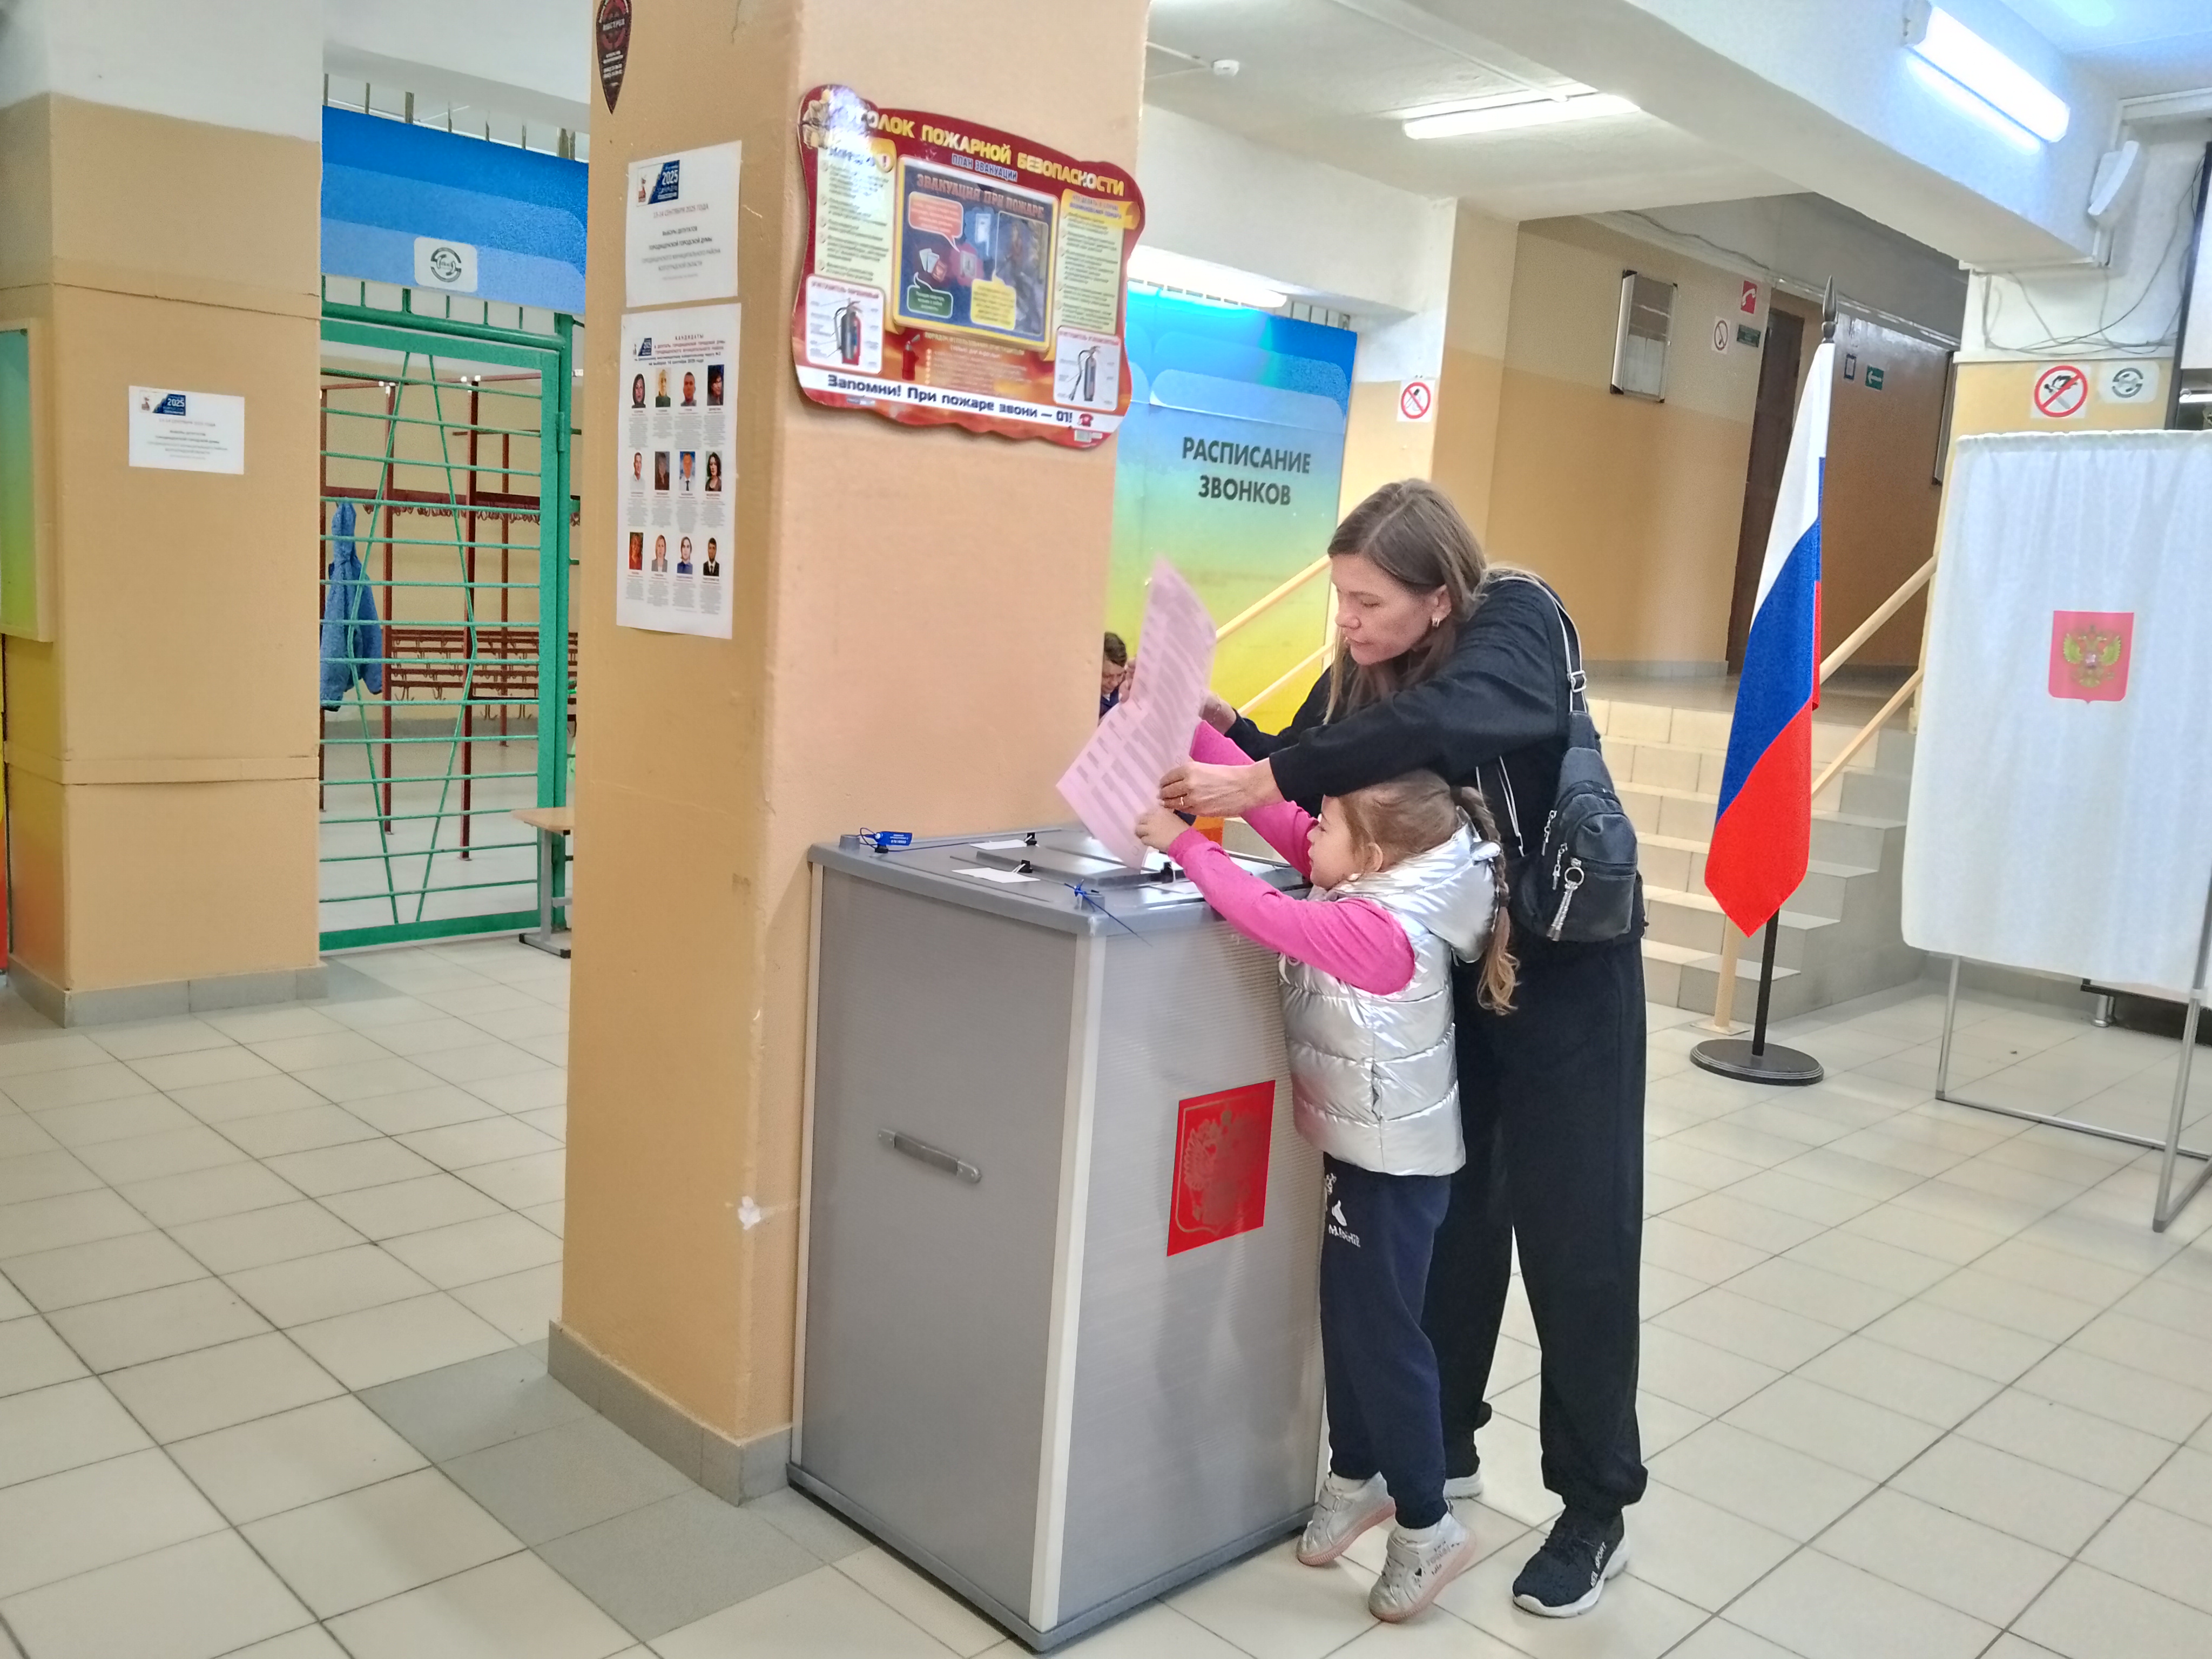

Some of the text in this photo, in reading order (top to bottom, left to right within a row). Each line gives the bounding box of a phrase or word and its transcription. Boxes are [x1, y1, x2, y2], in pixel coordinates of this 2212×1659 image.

[922, 124, 1011, 165] ПОЖАРНОЙ
[1017, 152, 1124, 197] БЕЗОПАСНОСТИ
[952, 153, 1018, 183] ПЛАН ЭВАКУАЦИИ
[662, 170, 678, 185] 2025
[167, 398, 185, 407] 2025
[828, 374, 901, 397] Запомни!
[907, 387, 936, 402] При
[942, 394, 994, 412] пожаре
[999, 404, 1037, 417] звони
[1056, 410, 1073, 423] 01!
[1182, 436, 1311, 474] РАСПИСАНИЕ
[1198, 474, 1291, 505] ЗВОНКОВ
